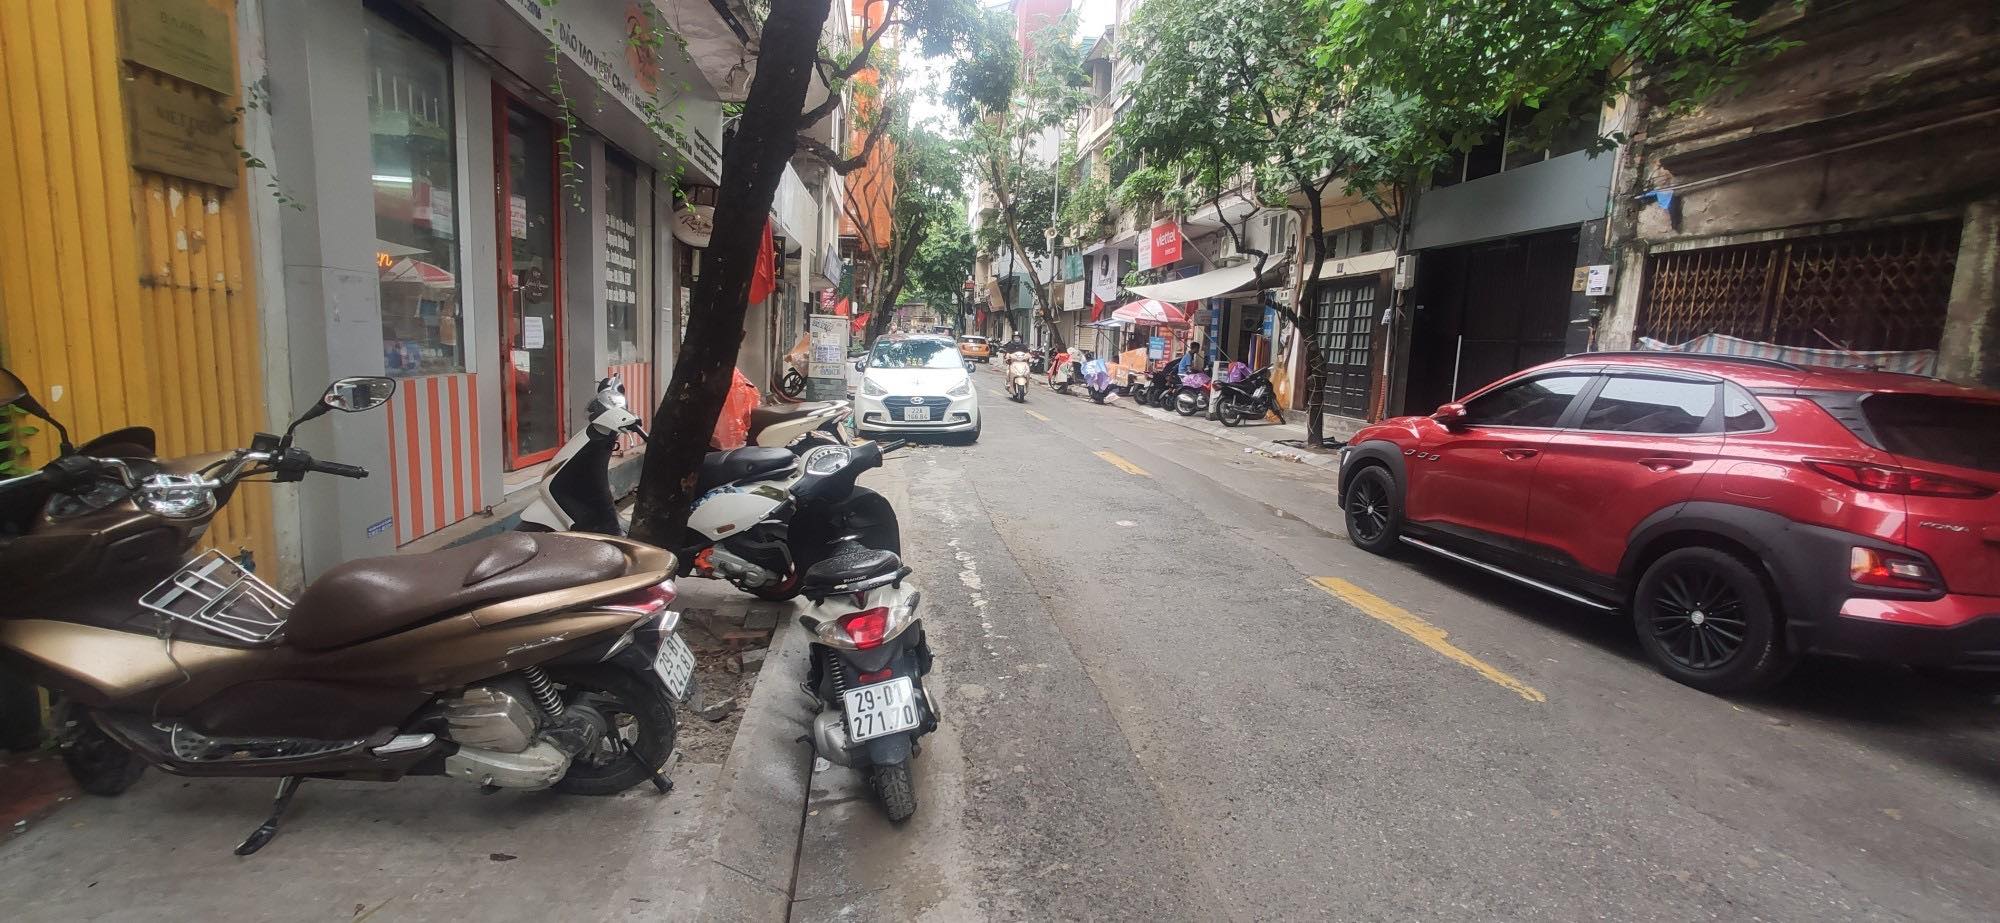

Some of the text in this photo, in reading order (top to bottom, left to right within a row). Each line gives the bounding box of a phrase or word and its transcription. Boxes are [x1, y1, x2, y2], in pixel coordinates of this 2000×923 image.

[1156, 229, 1176, 248] viettel
[854, 683, 904, 714] 29-D1
[853, 704, 914, 738] 271.70
